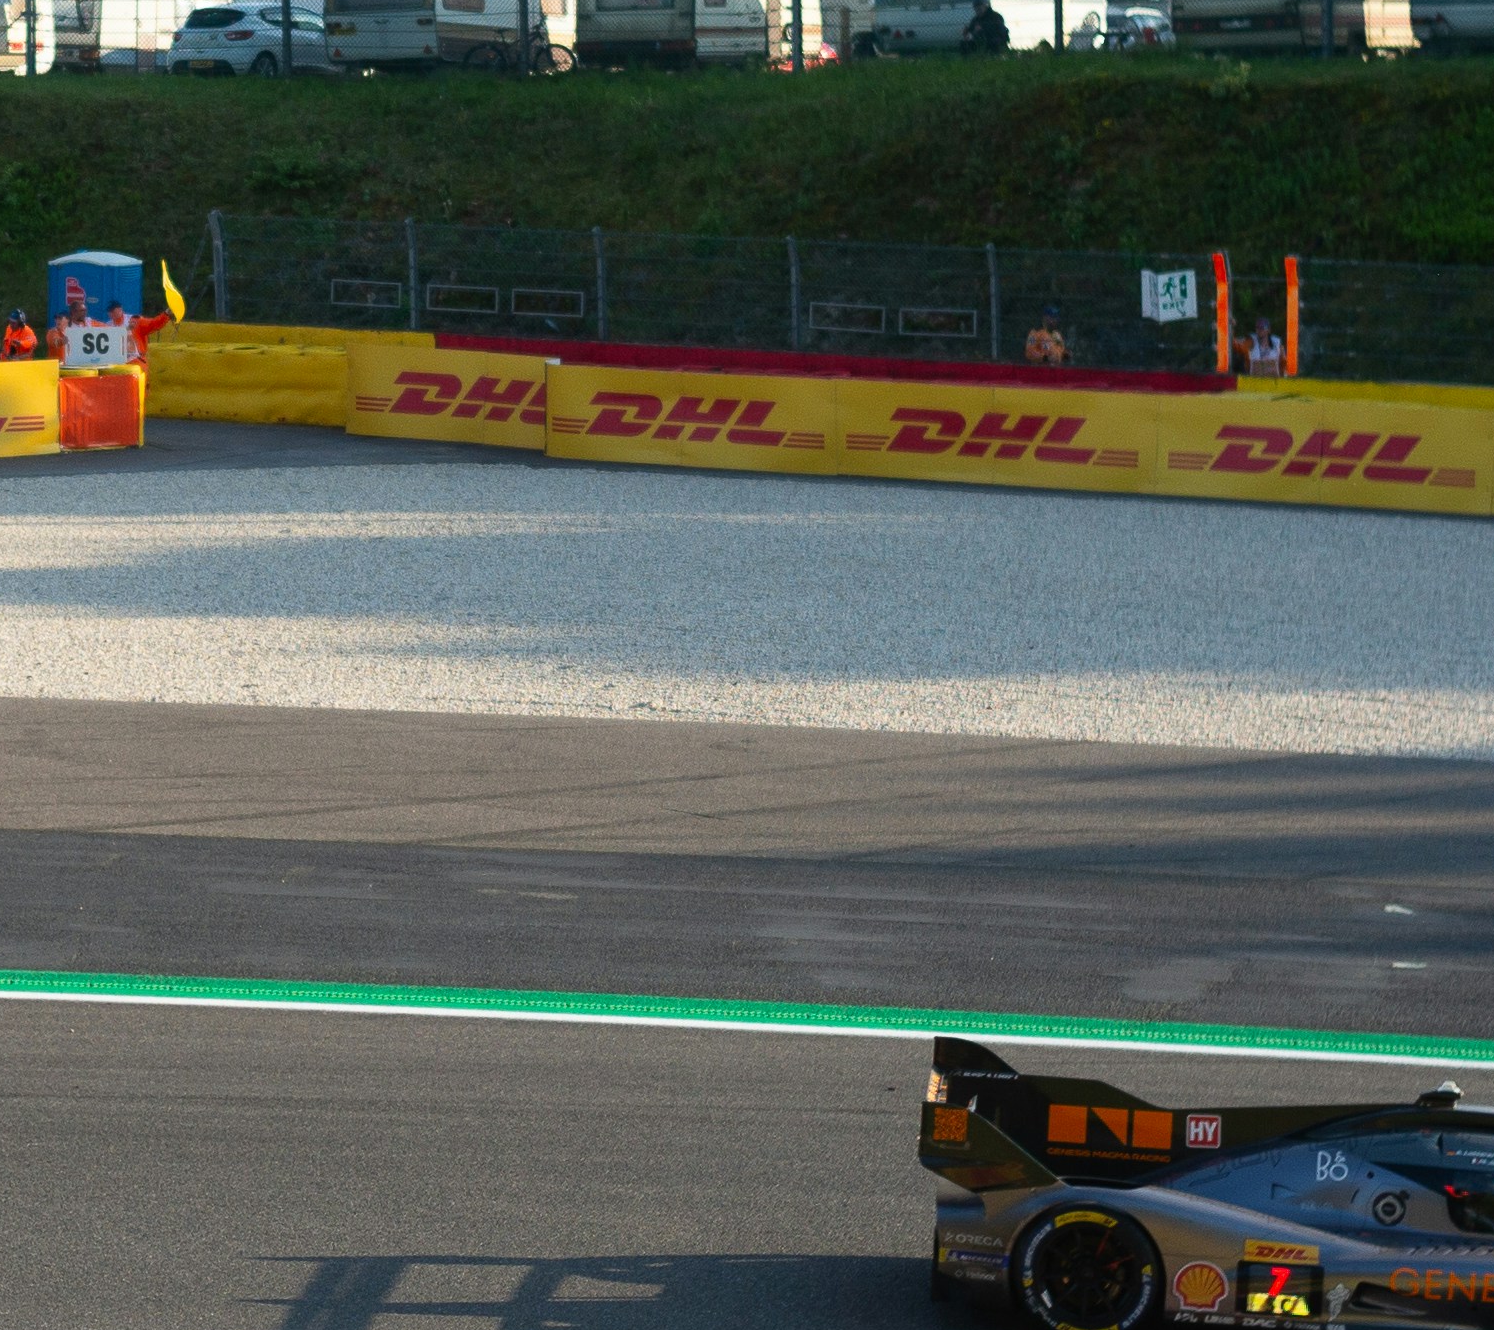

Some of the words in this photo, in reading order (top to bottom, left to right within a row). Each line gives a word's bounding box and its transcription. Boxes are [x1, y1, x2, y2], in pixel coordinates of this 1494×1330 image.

[1162, 300, 1186, 311] EXIT
[82, 332, 110, 355] SC
[585, 391, 787, 447] DHL
[886, 407, 1098, 465] DHL
[1212, 424, 1434, 485] DHL
[1189, 1122, 1218, 1142] HY
[955, 1233, 1004, 1248] ORECA
[1254, 1245, 1309, 1261] DHL
